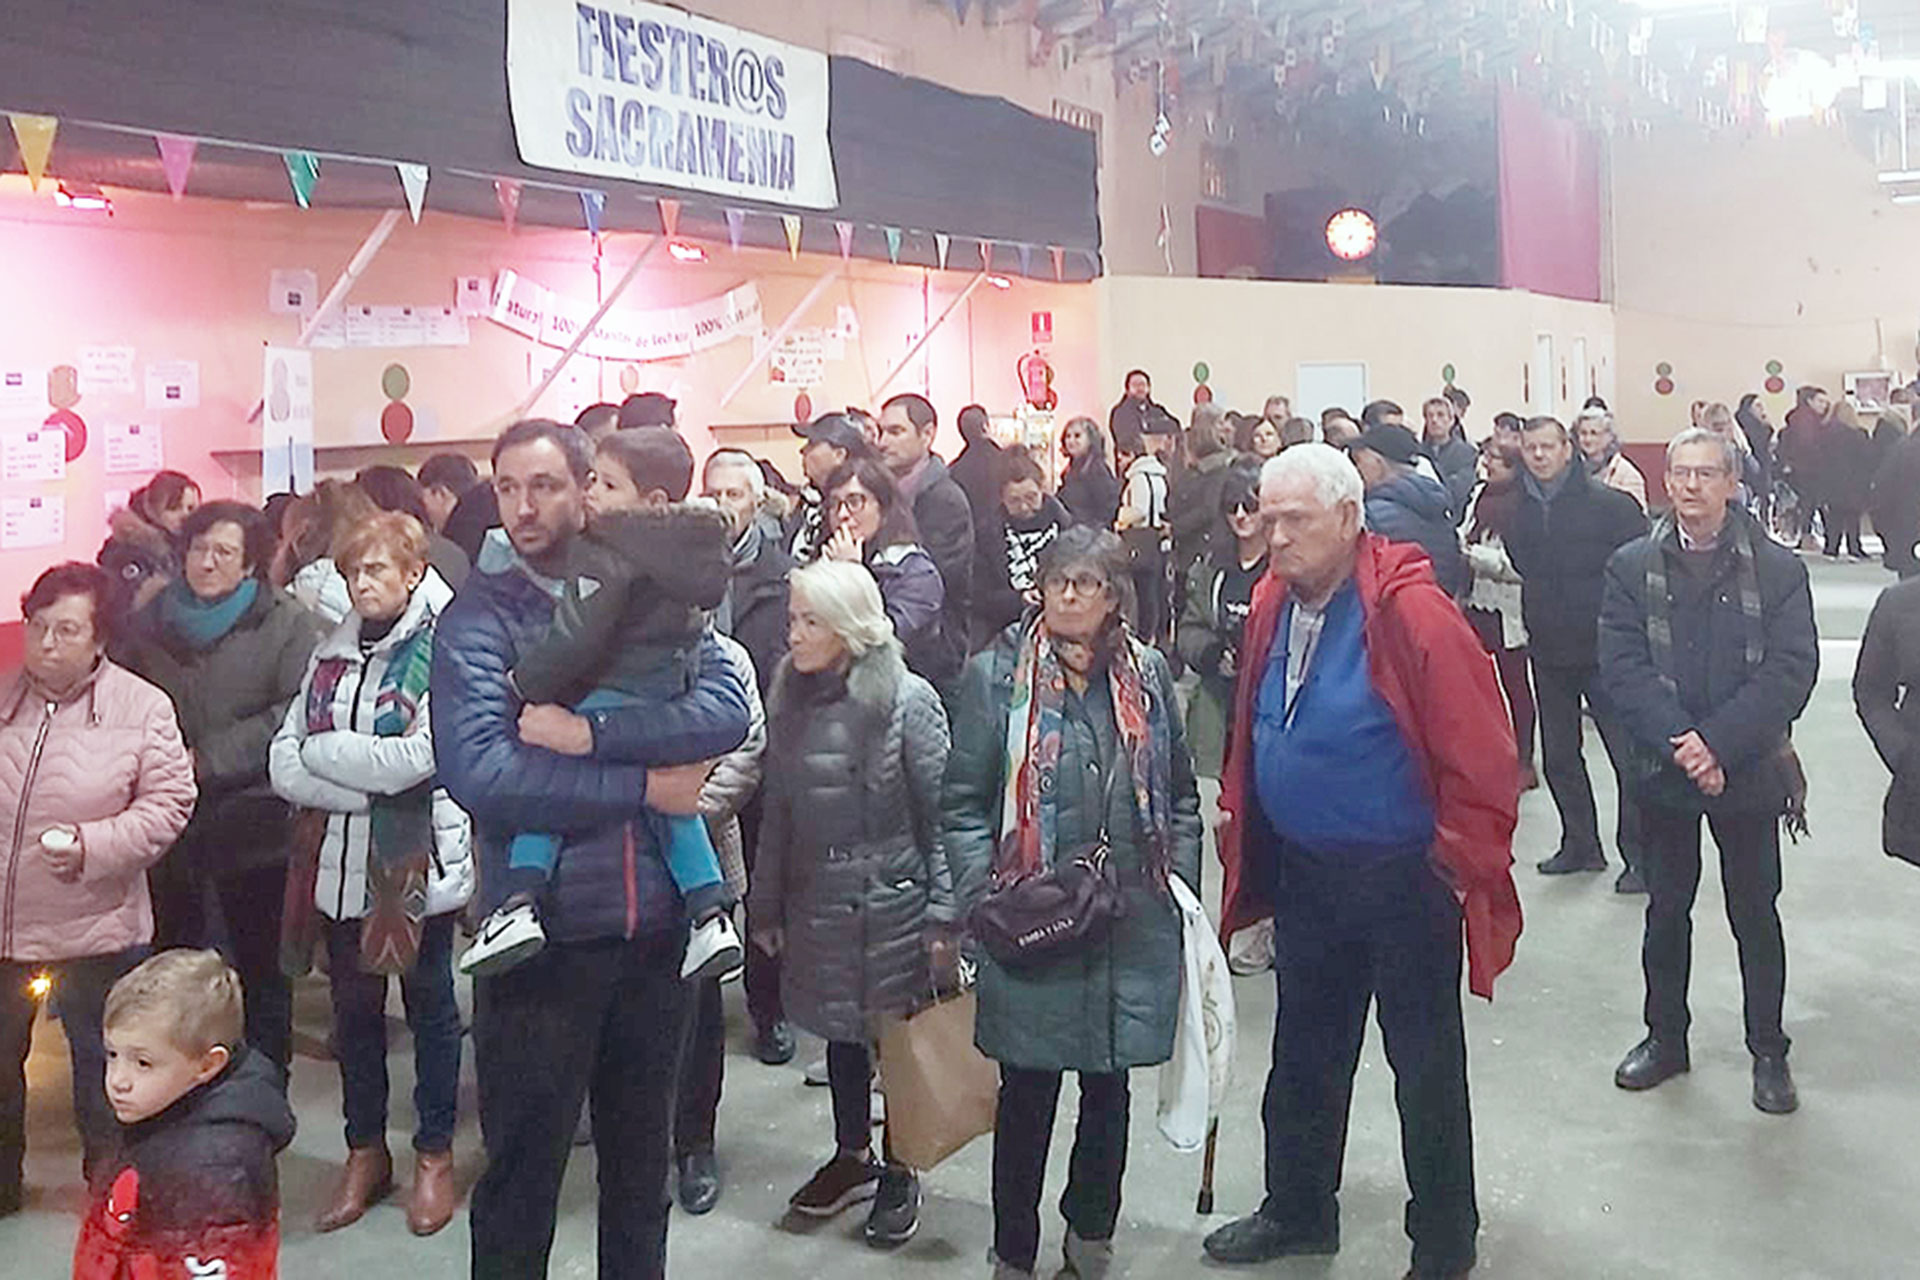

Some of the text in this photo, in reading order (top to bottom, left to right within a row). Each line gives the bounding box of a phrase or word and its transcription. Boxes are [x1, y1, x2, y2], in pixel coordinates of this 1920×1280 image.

[576, 2, 787, 120] FIESTER@S
[565, 87, 796, 192] SACRAMENIA
[694, 315, 723, 338] 100%
